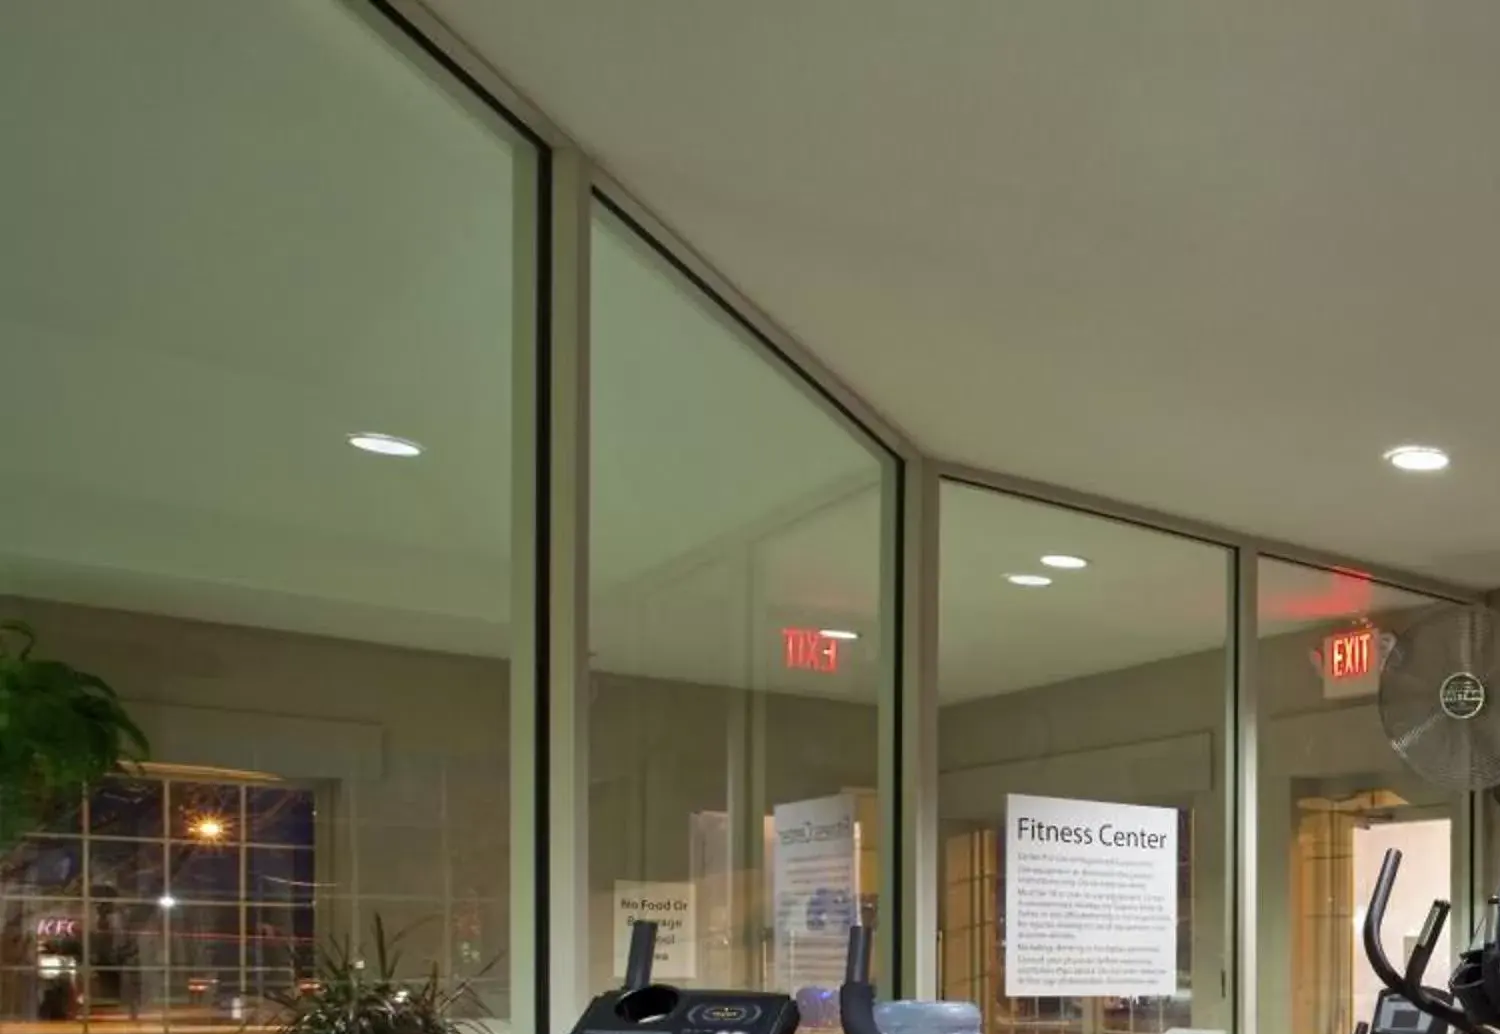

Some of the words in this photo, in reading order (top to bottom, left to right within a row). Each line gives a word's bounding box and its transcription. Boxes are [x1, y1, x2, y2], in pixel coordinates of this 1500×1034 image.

[1333, 633, 1371, 677] EXIT
[1017, 817, 1093, 845] Fitness
[1099, 824, 1167, 849] Center
[621, 898, 638, 910] No
[641, 899, 671, 911] Food
[674, 900, 688, 911] Or
[37, 919, 76, 936] KFC
